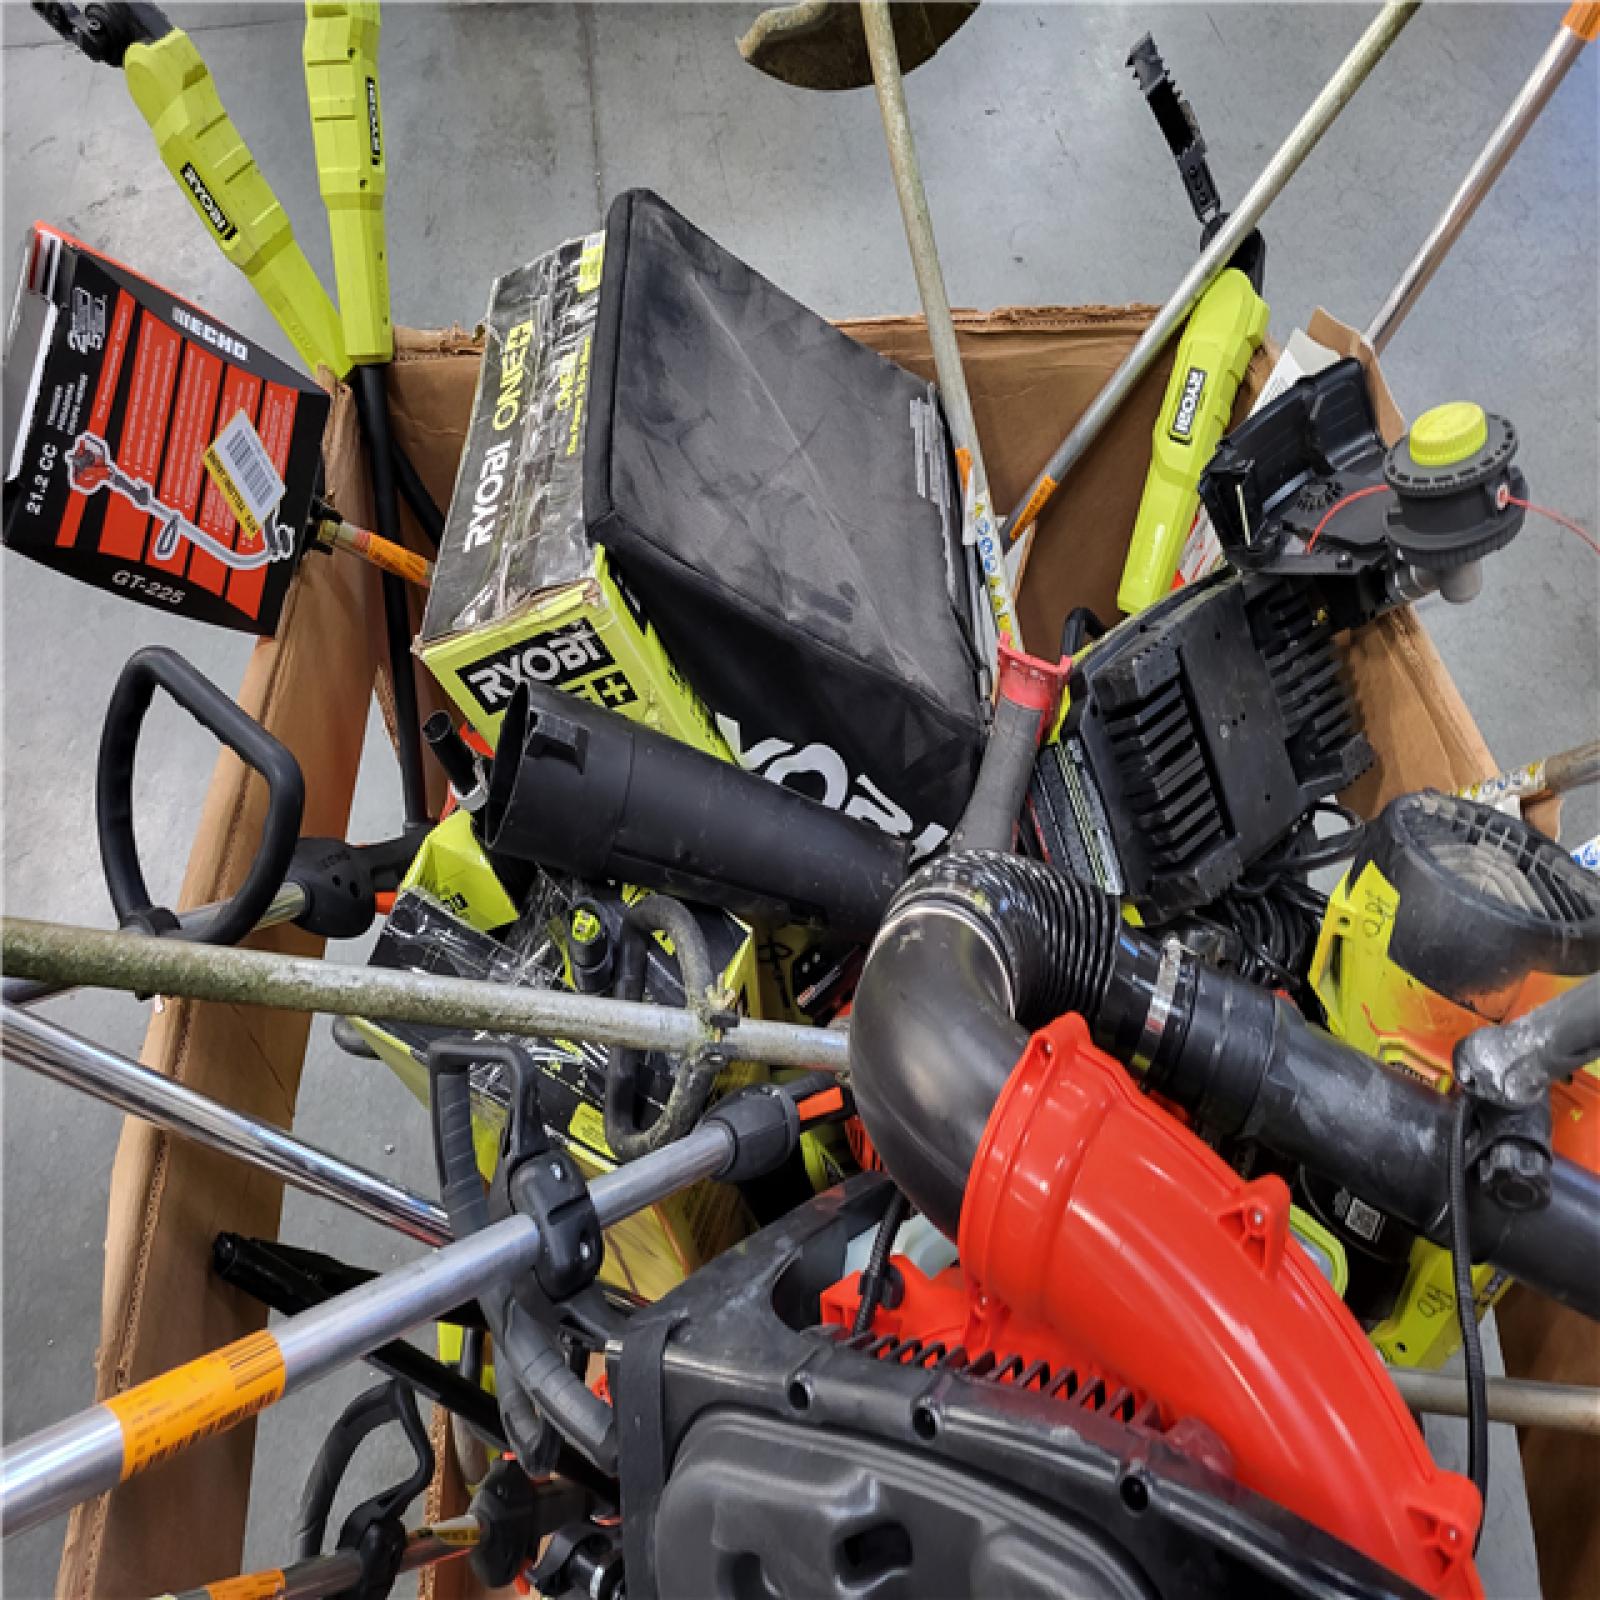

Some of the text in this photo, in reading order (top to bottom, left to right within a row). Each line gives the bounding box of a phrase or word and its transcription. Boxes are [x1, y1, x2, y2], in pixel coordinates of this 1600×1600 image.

[184, 167, 226, 229] RYOBI
[189, 317, 248, 360] ECHO
[1175, 371, 1204, 431] RYOBI
[462, 320, 534, 553] RYOBI ONE+
[25, 474, 50, 515] 21.2
[39, 442, 58, 471] CC
[112, 570, 186, 603] GT-225
[467, 637, 602, 703] RYOBI
[714, 712, 949, 864] YOBI
